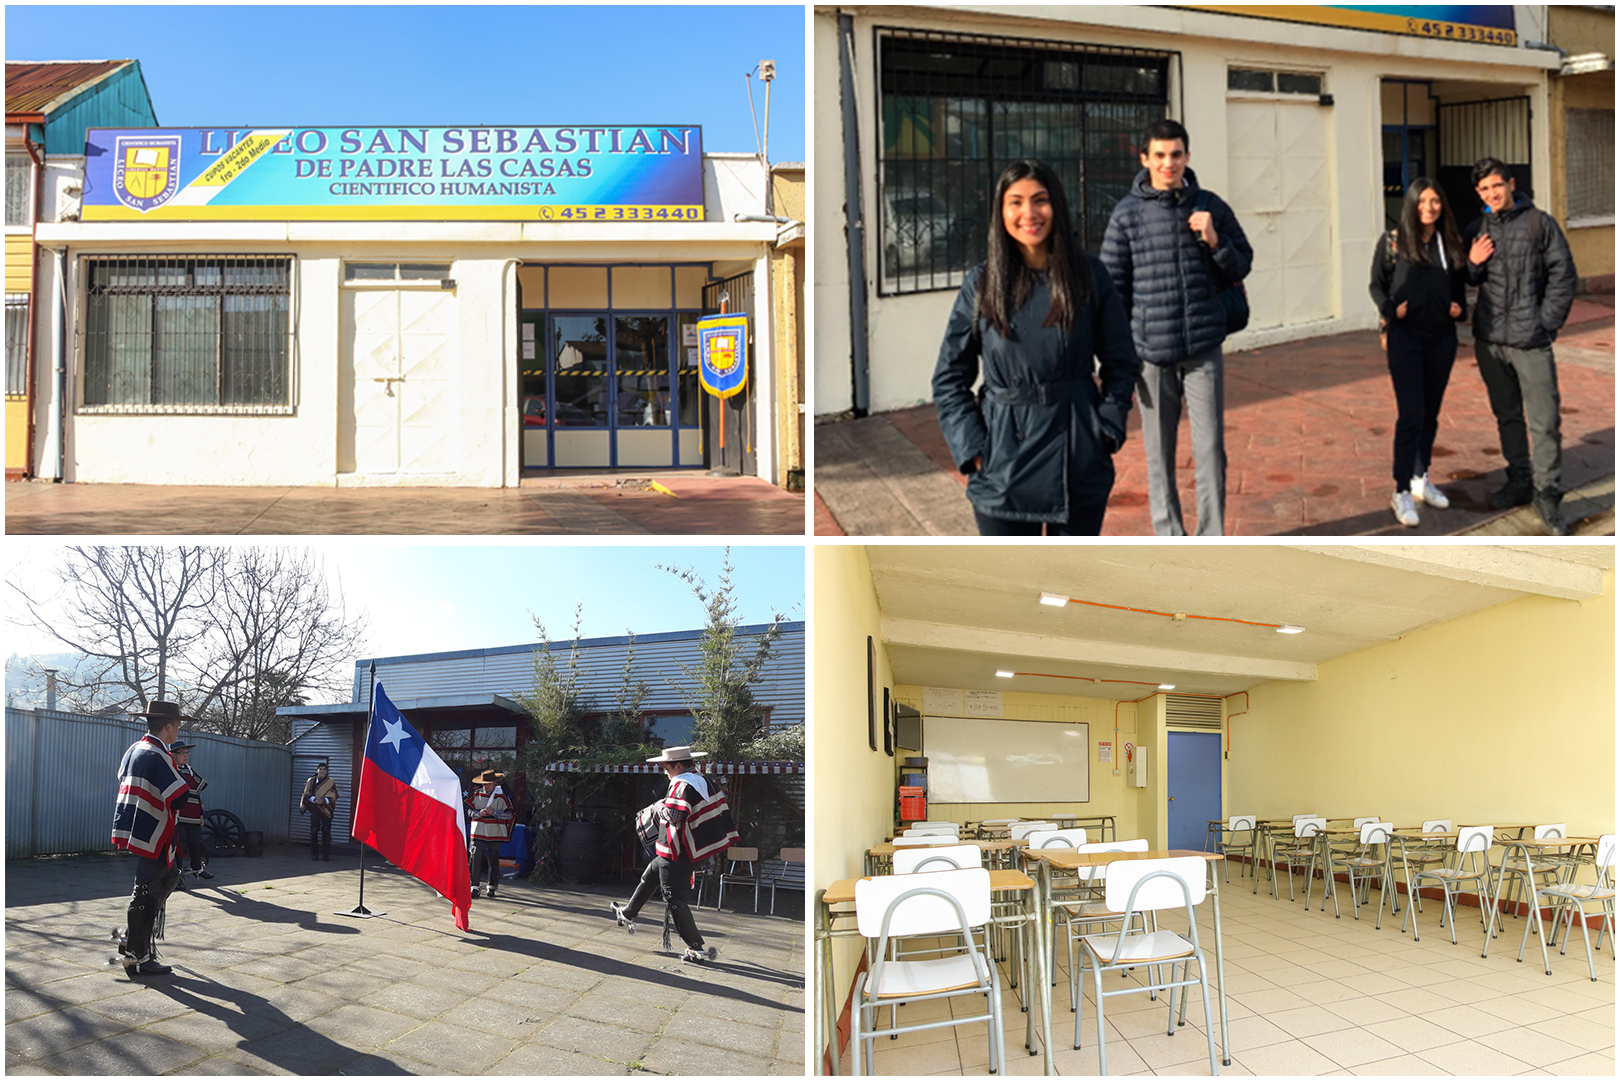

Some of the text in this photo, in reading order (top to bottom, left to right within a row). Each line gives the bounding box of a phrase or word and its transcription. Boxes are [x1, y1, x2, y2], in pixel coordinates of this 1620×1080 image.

[1422, 22, 1513, 45] 45 2 333440
[198, 128, 691, 155] LIEO SAN SEBASTIAN
[235, 154, 250, 170] 2do
[248, 138, 271, 159] Medio
[205, 136, 254, 182] CUPOS VACANTES
[295, 158, 594, 179] DE PADRE LAS CASAS
[116, 158, 177, 207] LICEO SAN SEBASTIAN
[329, 182, 557, 196] CIENTIFICO HUMANISTA
[560, 207, 699, 220] 45 2 333440
